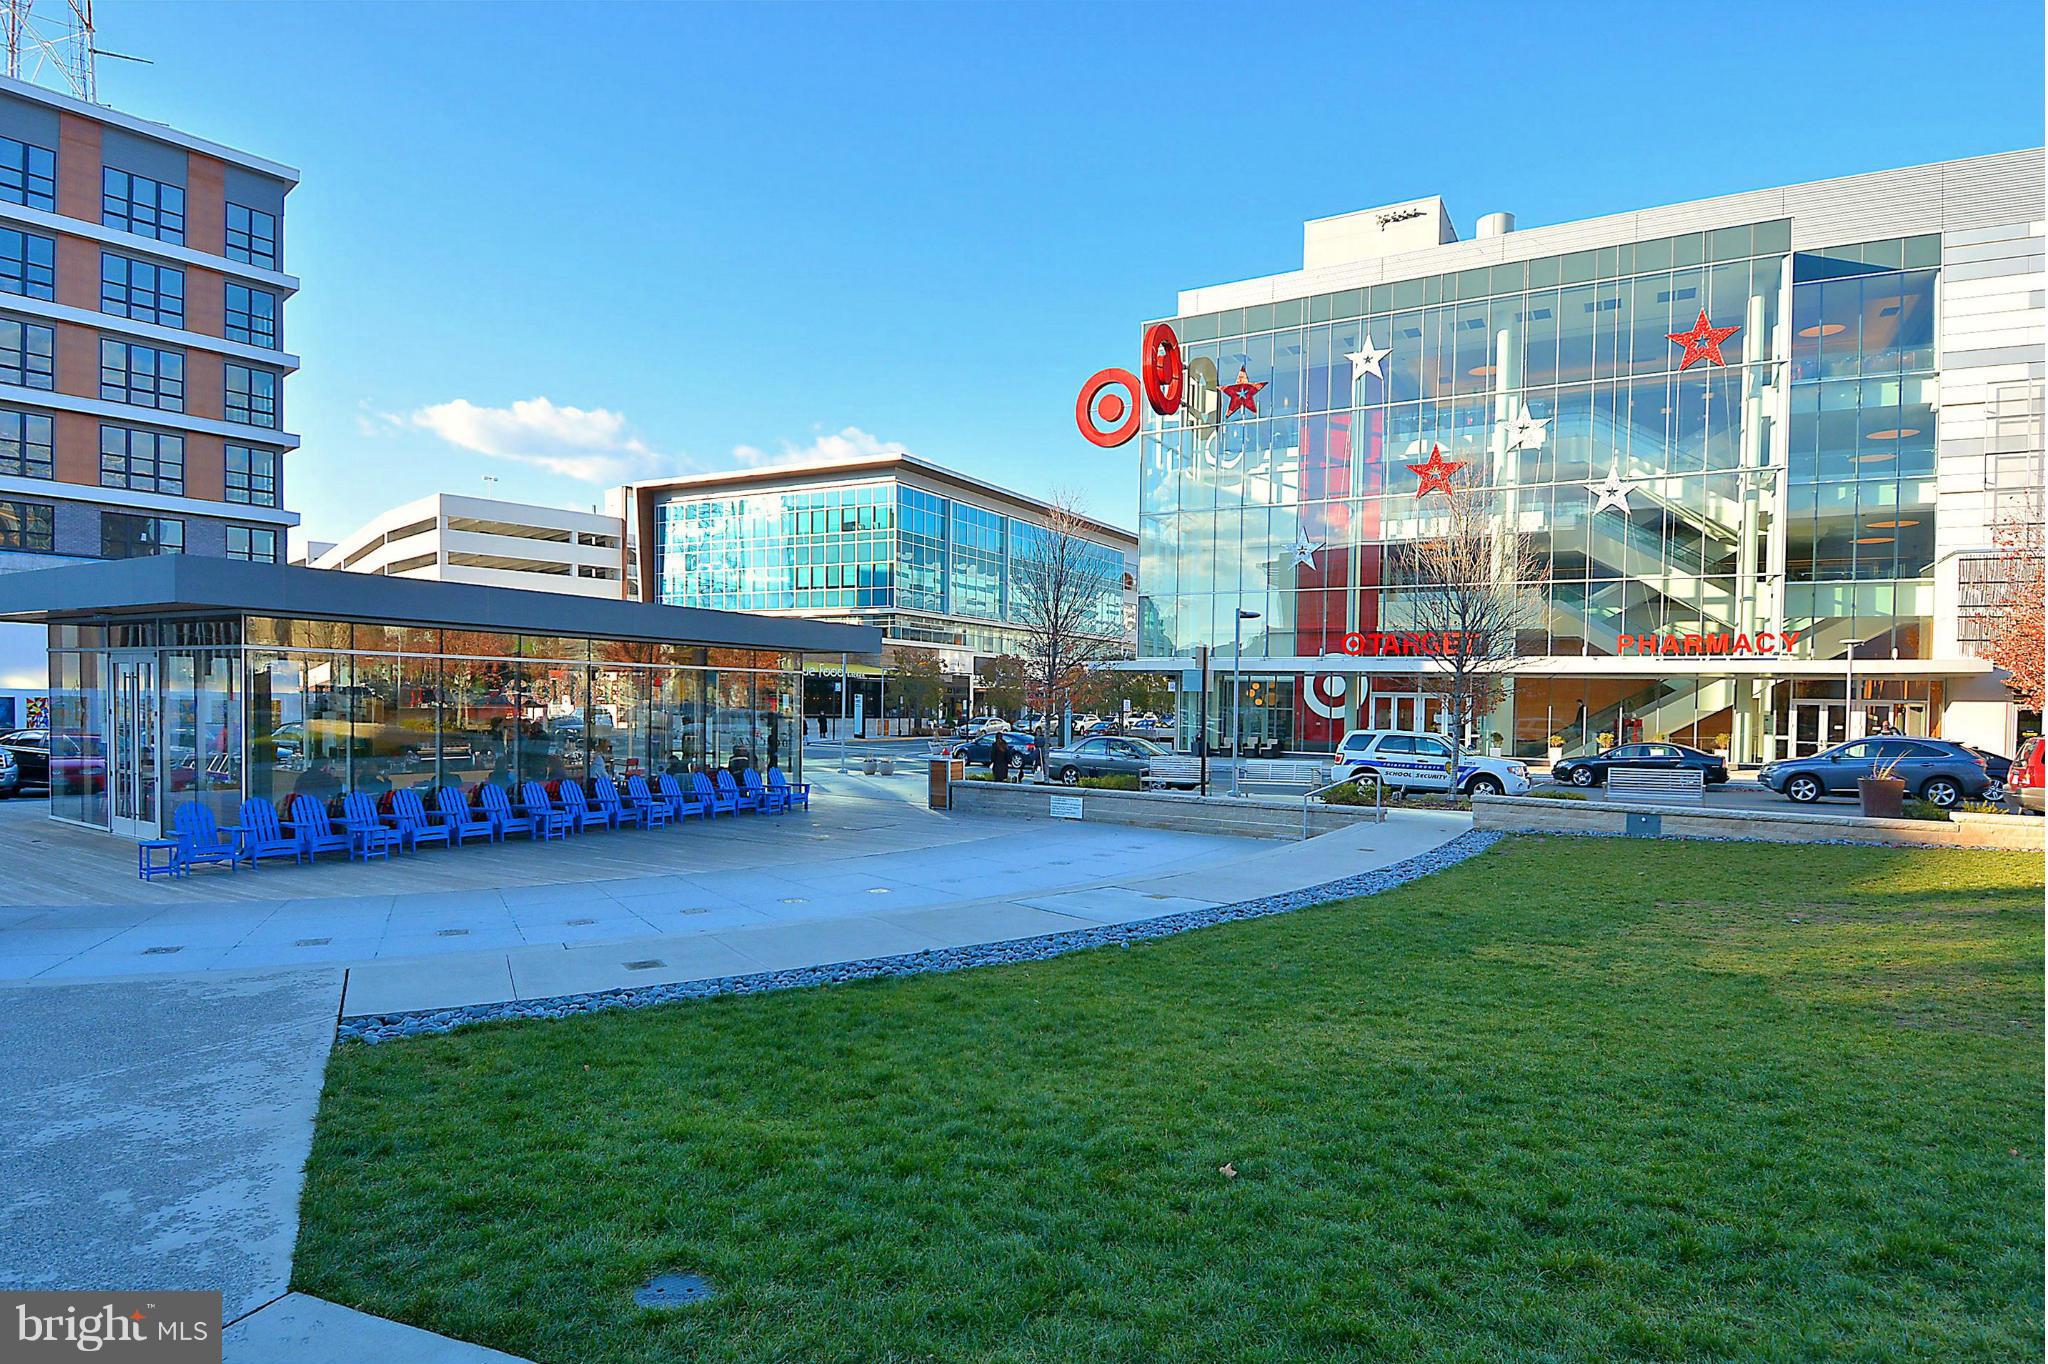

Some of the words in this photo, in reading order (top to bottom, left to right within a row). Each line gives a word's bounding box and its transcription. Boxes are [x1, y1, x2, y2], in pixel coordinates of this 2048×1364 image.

[1368, 631, 1481, 655] TARGET
[1617, 631, 1801, 654] PHARMACY
[1385, 770, 1412, 778] SCHOOL
[1415, 772, 1448, 780] SECURITY
